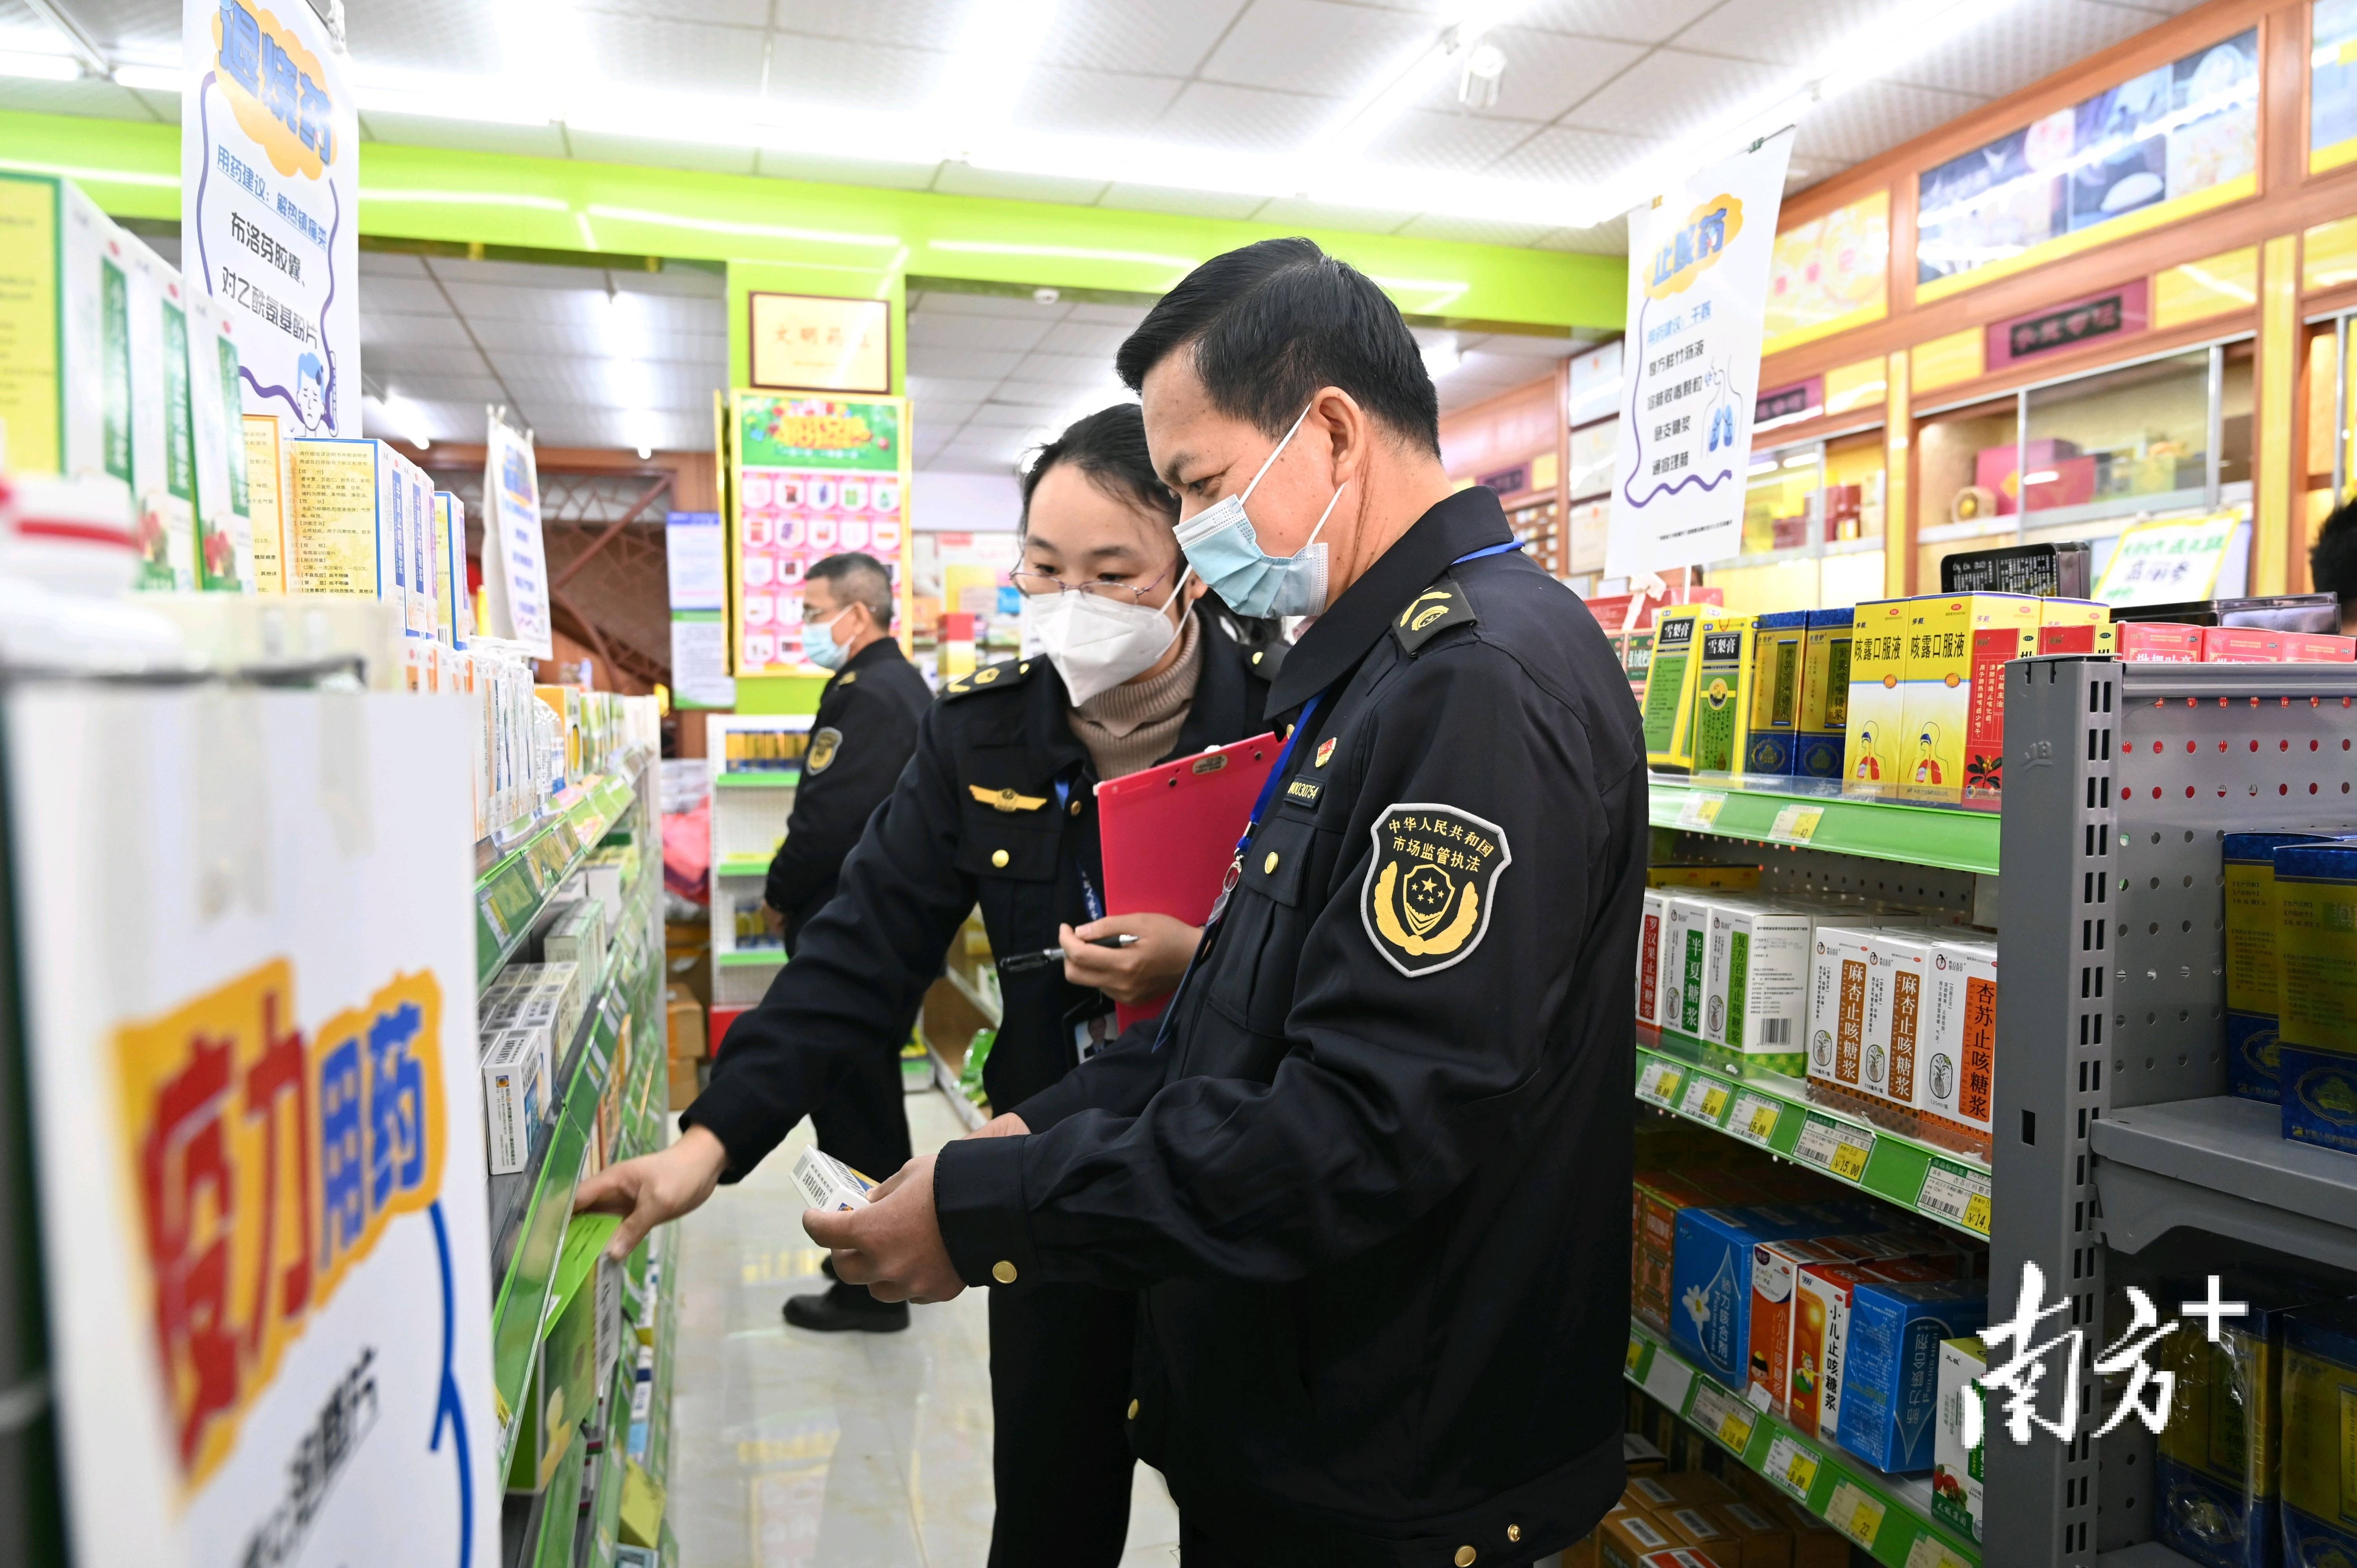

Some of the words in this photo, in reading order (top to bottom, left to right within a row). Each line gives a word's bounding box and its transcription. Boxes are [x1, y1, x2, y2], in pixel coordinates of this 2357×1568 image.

[222, 266, 318, 349] 对乙酰氨基酚片
[1665, 622, 1689, 639] 雪梨膏
[1708, 637, 1736, 654] 雪梨膏
[1854, 635, 1901, 661] 咳露口服液
[1910, 632, 1965, 659] 咳露口服液
[1996, 674, 2005, 708] 功能主治
[1388, 816, 1494, 858] 中华人民共和国
[1393, 835, 1482, 873] 市场监管执法
[1644, 917, 1657, 1017] 罗汉果止咳糖浆
[1686, 937, 1701, 1027] 半夏糖浆
[1731, 934, 1745, 1044] 复方百部止咳糖浆
[1841, 964, 1864, 1079] 麻杏止咳糖浆
[1894, 975, 1917, 1097] 麻杏止咳糖浆
[1968, 983, 1995, 1119] 杏苏止咳糖浆
[1930, 1099, 1948, 1110] 125ml/瓶
[1932, 1159, 1965, 1176] 商品标价签
[1801, 1275, 1812, 1286] 999
[1772, 1309, 1787, 1398] 小儿止咳糖浆
[1825, 1304, 1842, 1412] 小儿止咳糖浆
[1945, 1354, 1960, 1367] 太极
[1859, 1521, 1870, 1537] 22
[1936, 1501, 1967, 1526] 太极集团
